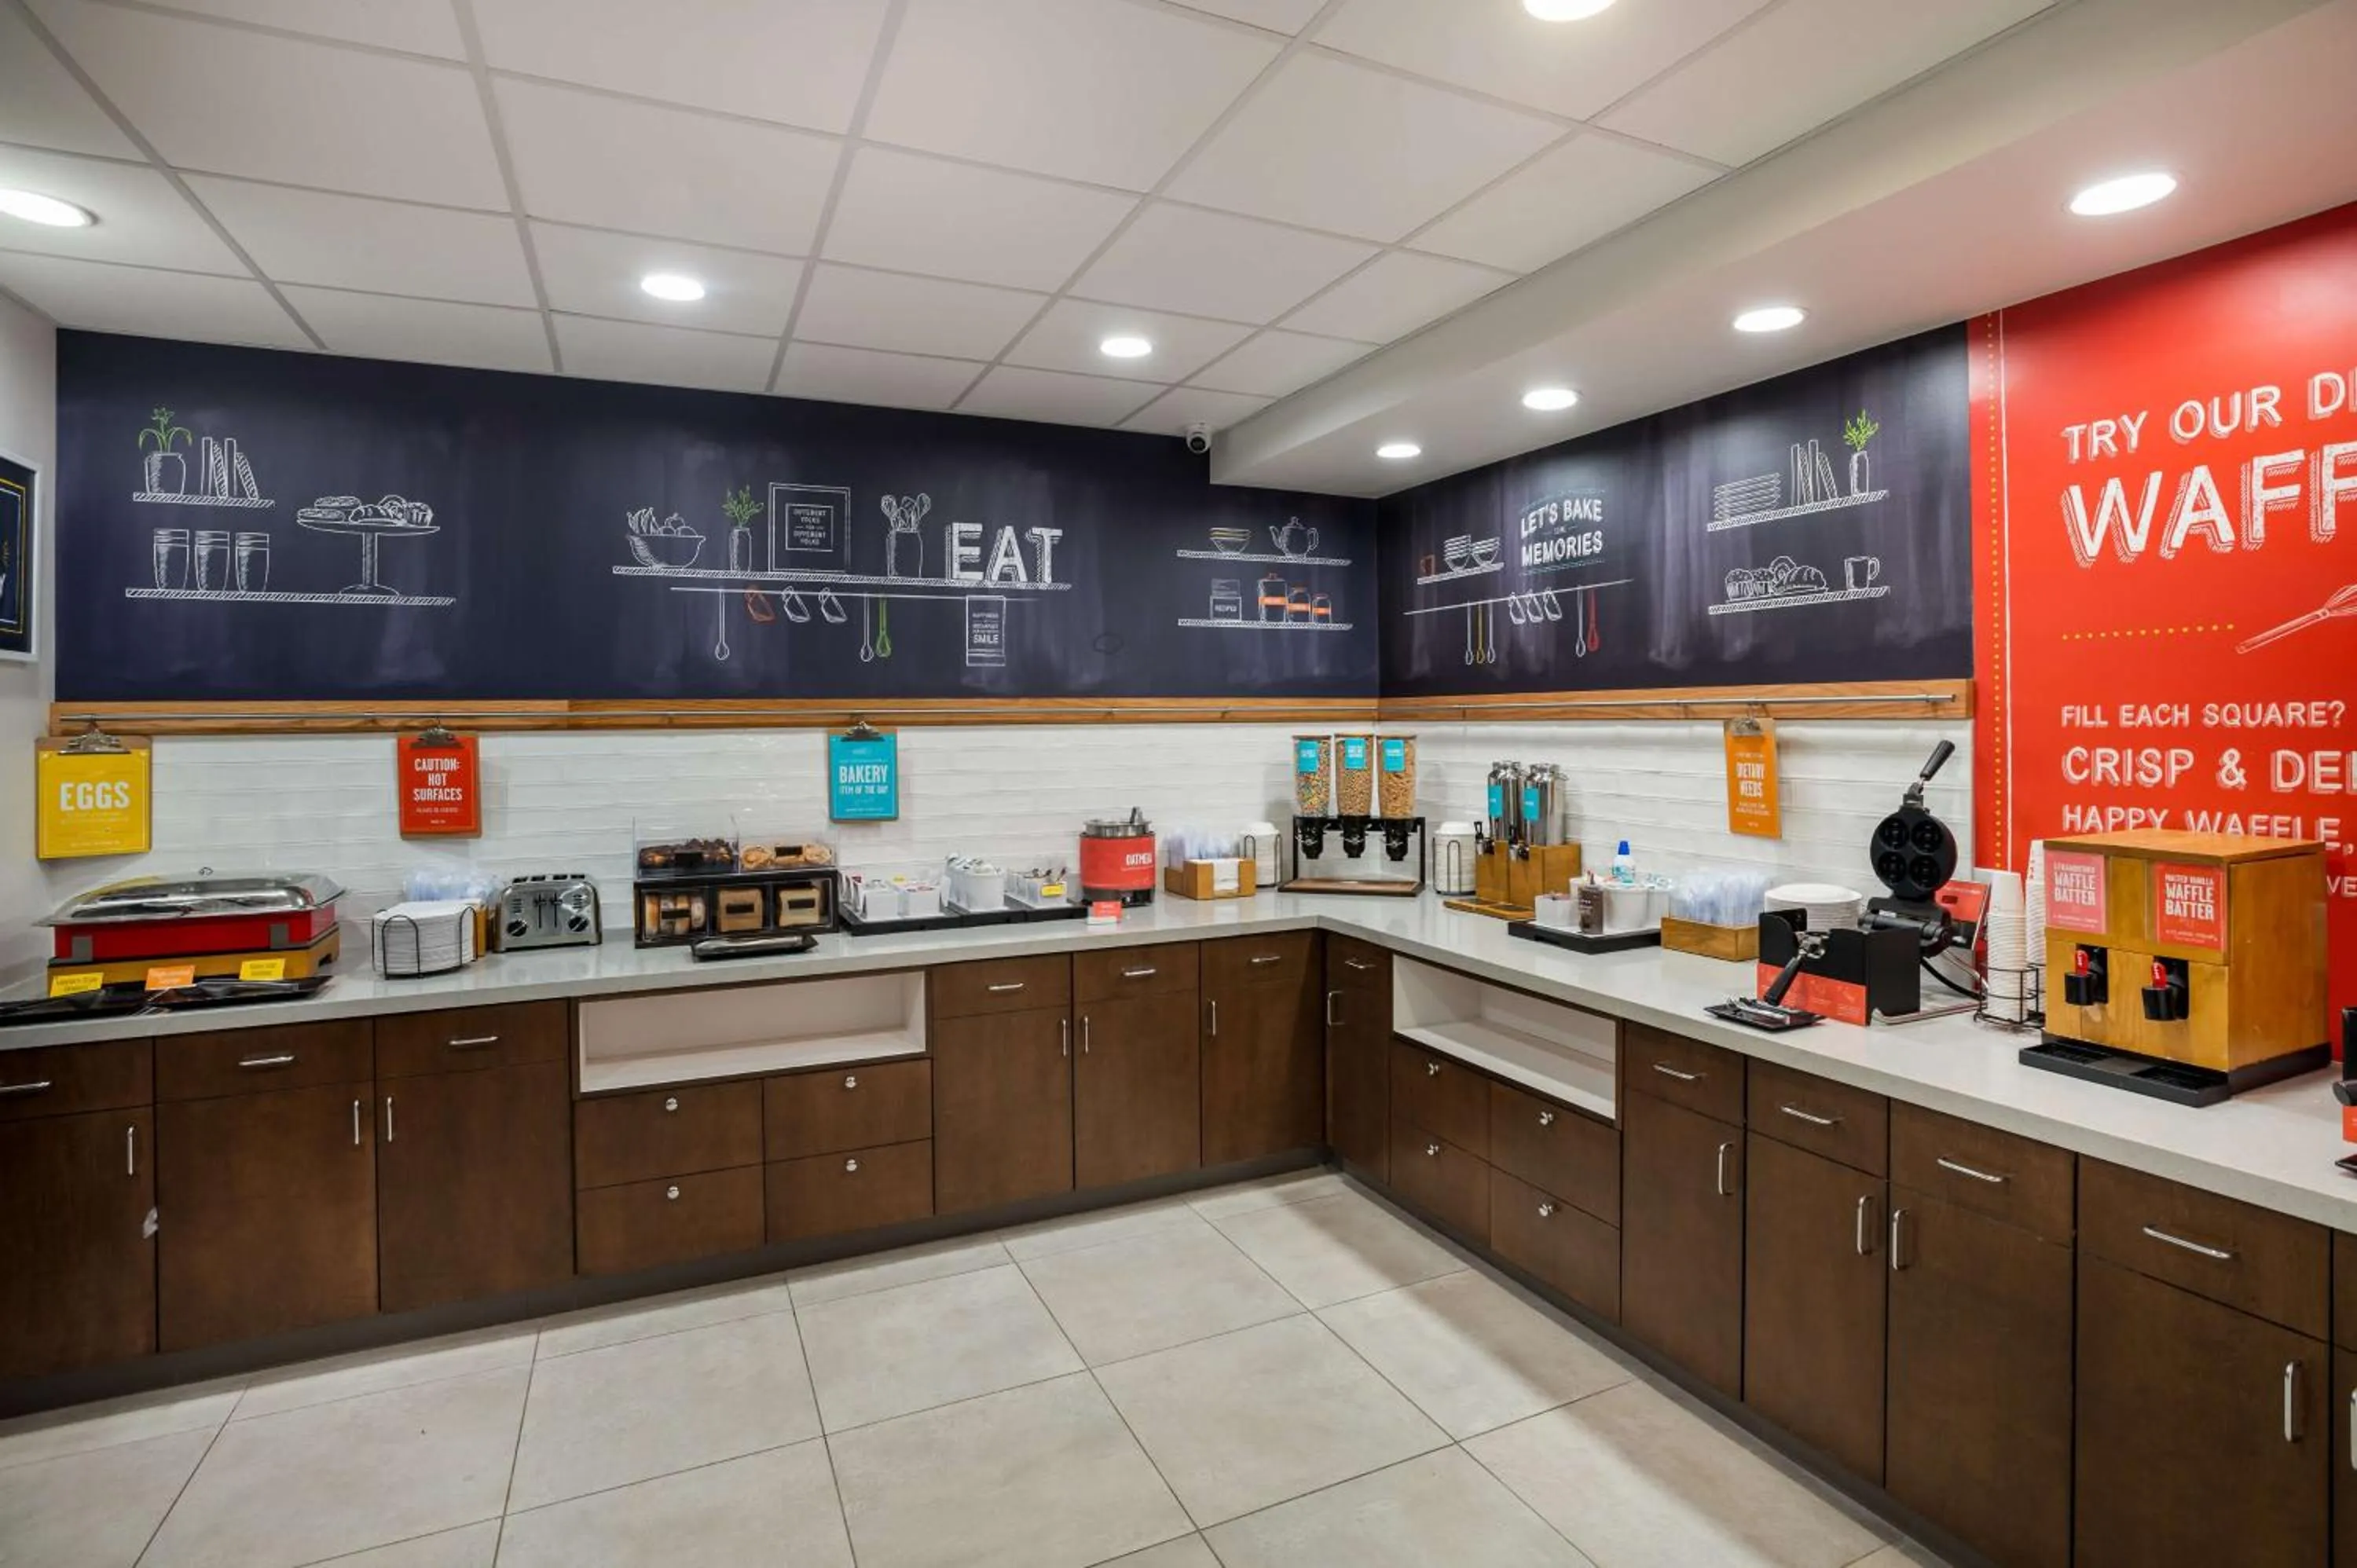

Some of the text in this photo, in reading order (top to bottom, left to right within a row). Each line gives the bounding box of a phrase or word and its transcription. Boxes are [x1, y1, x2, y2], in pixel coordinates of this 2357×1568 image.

[2062, 366, 2357, 463] TRY OUR D
[2061, 441, 2357, 568] WAFF
[1521, 497, 1603, 539] LET'S BAKE
[946, 522, 1063, 584] EAT
[1522, 530, 1603, 566] MEMORIES
[973, 634, 999, 643] SMILE
[2061, 700, 2346, 728] FILL EACH SQUARE?
[414, 758, 463, 771] CAUTION:
[839, 764, 888, 784] BAKERY
[2062, 746, 2194, 787] CRISP
[2216, 748, 2247, 789] &
[427, 773, 447, 786] HOT
[60, 780, 131, 811] EGGS
[413, 788, 463, 802] SURFACES
[2062, 804, 2169, 832] HAPPY
[2054, 871, 2097, 890] WAFFLE
[2165, 882, 2214, 904] WAFFLE
[2054, 888, 2096, 906] BATTER
[2165, 899, 2214, 921] BATTER
